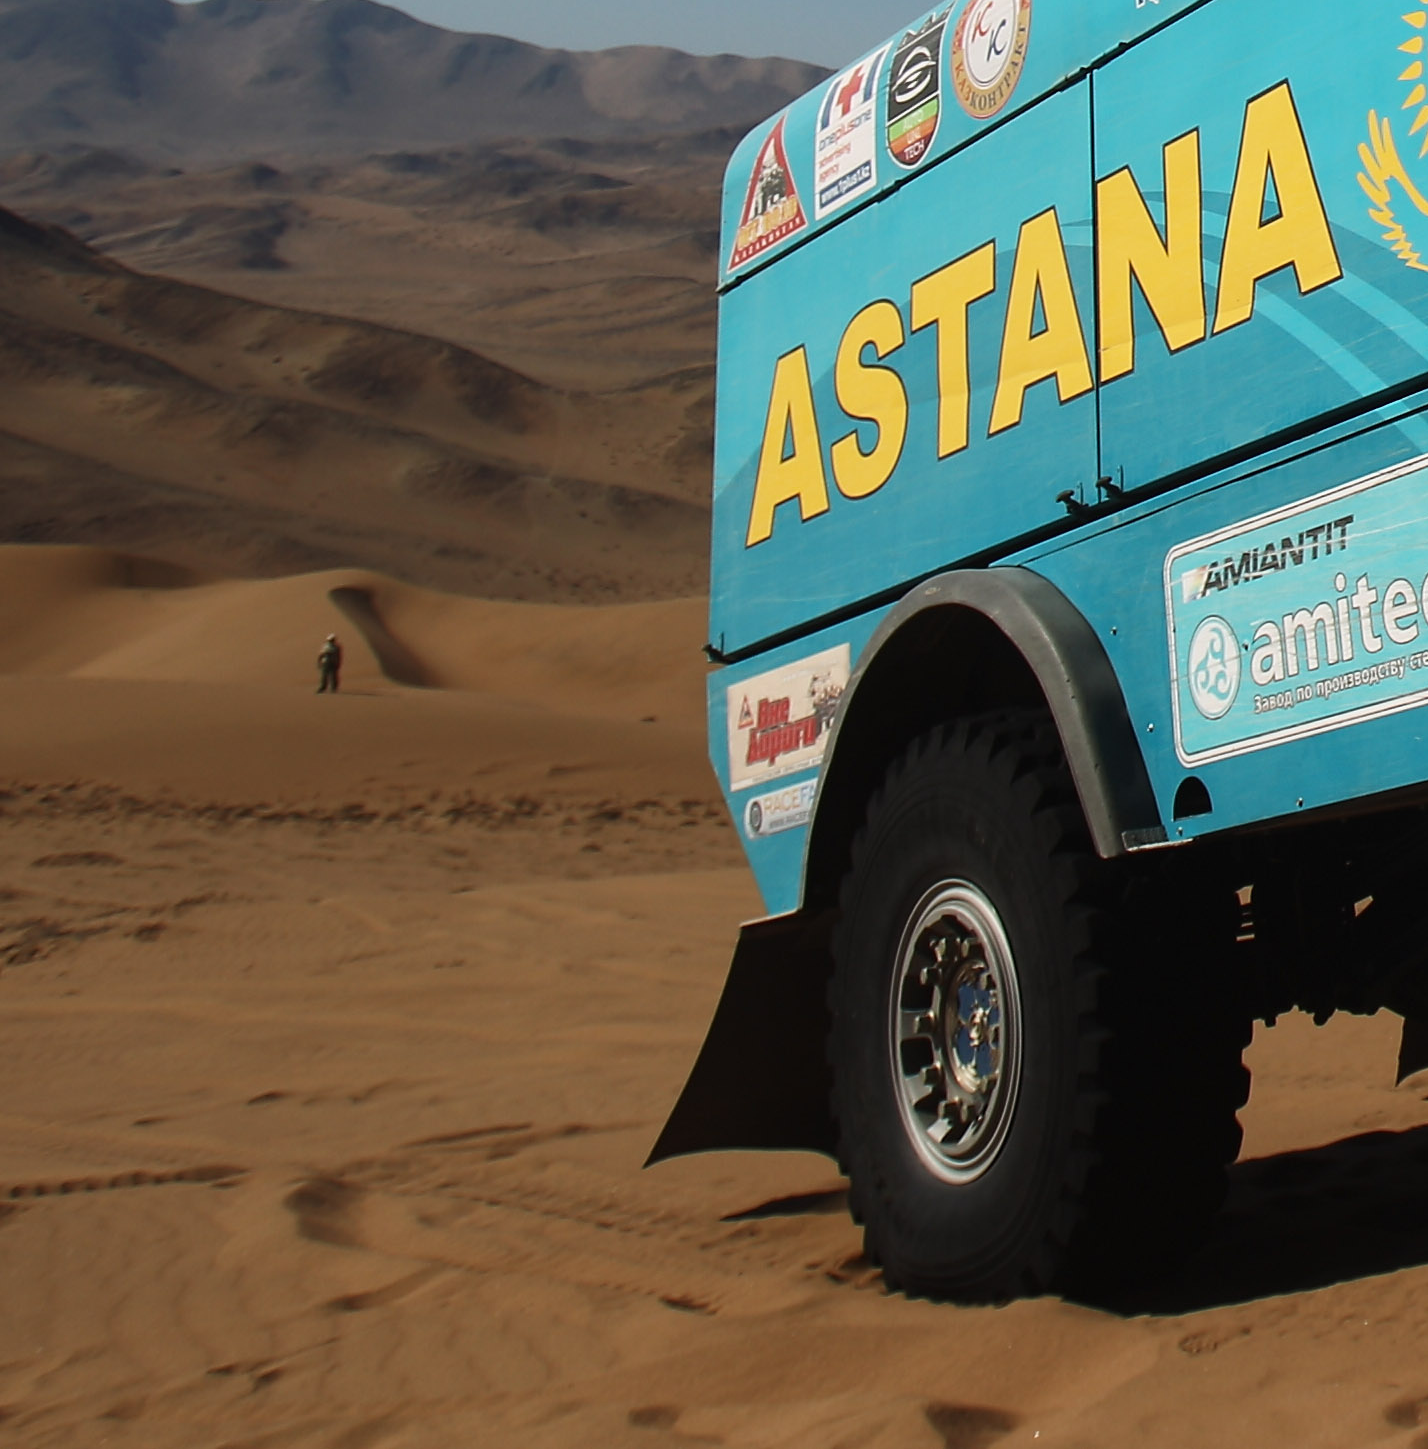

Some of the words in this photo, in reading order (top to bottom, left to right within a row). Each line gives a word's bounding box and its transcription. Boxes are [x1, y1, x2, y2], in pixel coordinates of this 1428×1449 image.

[745, 78, 1344, 549] ASTANA
[1198, 514, 1355, 599] AMIANTIT
[1254, 690, 1293, 714] Завод
[1296, 684, 1312, 702] по
[1317, 657, 1406, 699] производству
